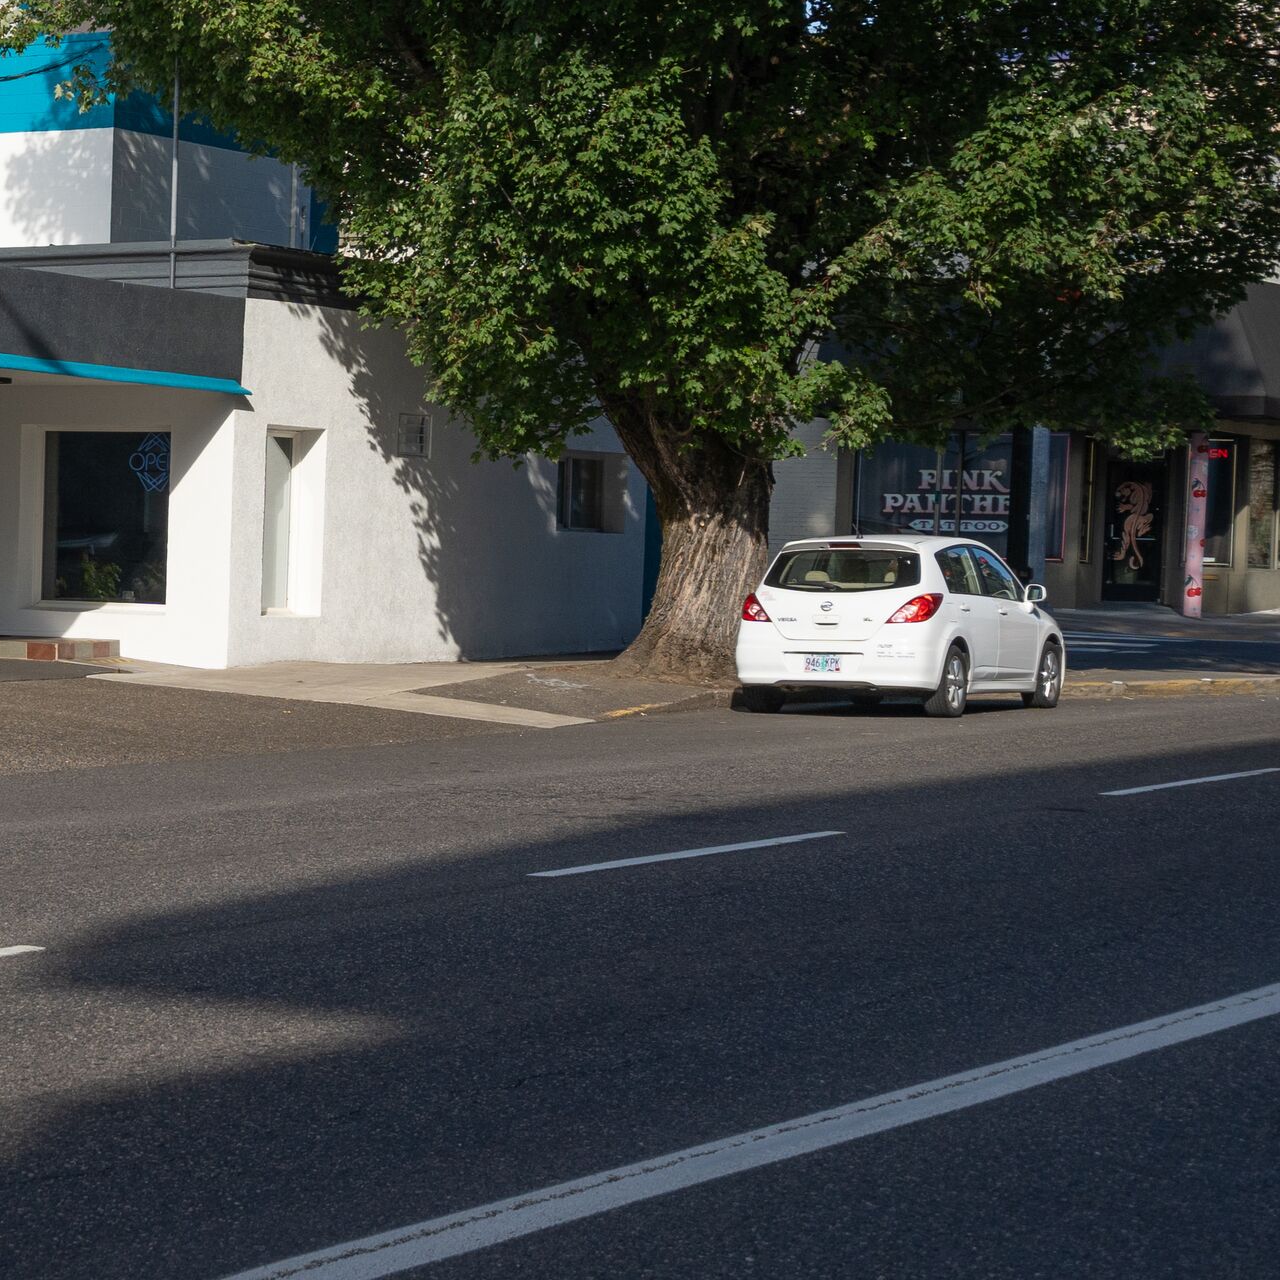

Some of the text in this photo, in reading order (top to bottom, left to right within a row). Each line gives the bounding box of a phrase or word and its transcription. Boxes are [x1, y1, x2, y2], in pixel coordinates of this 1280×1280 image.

[1209, 448, 1229, 458] EN
[918, 469, 1011, 493] PINK
[883, 493, 1010, 515] PANTHE
